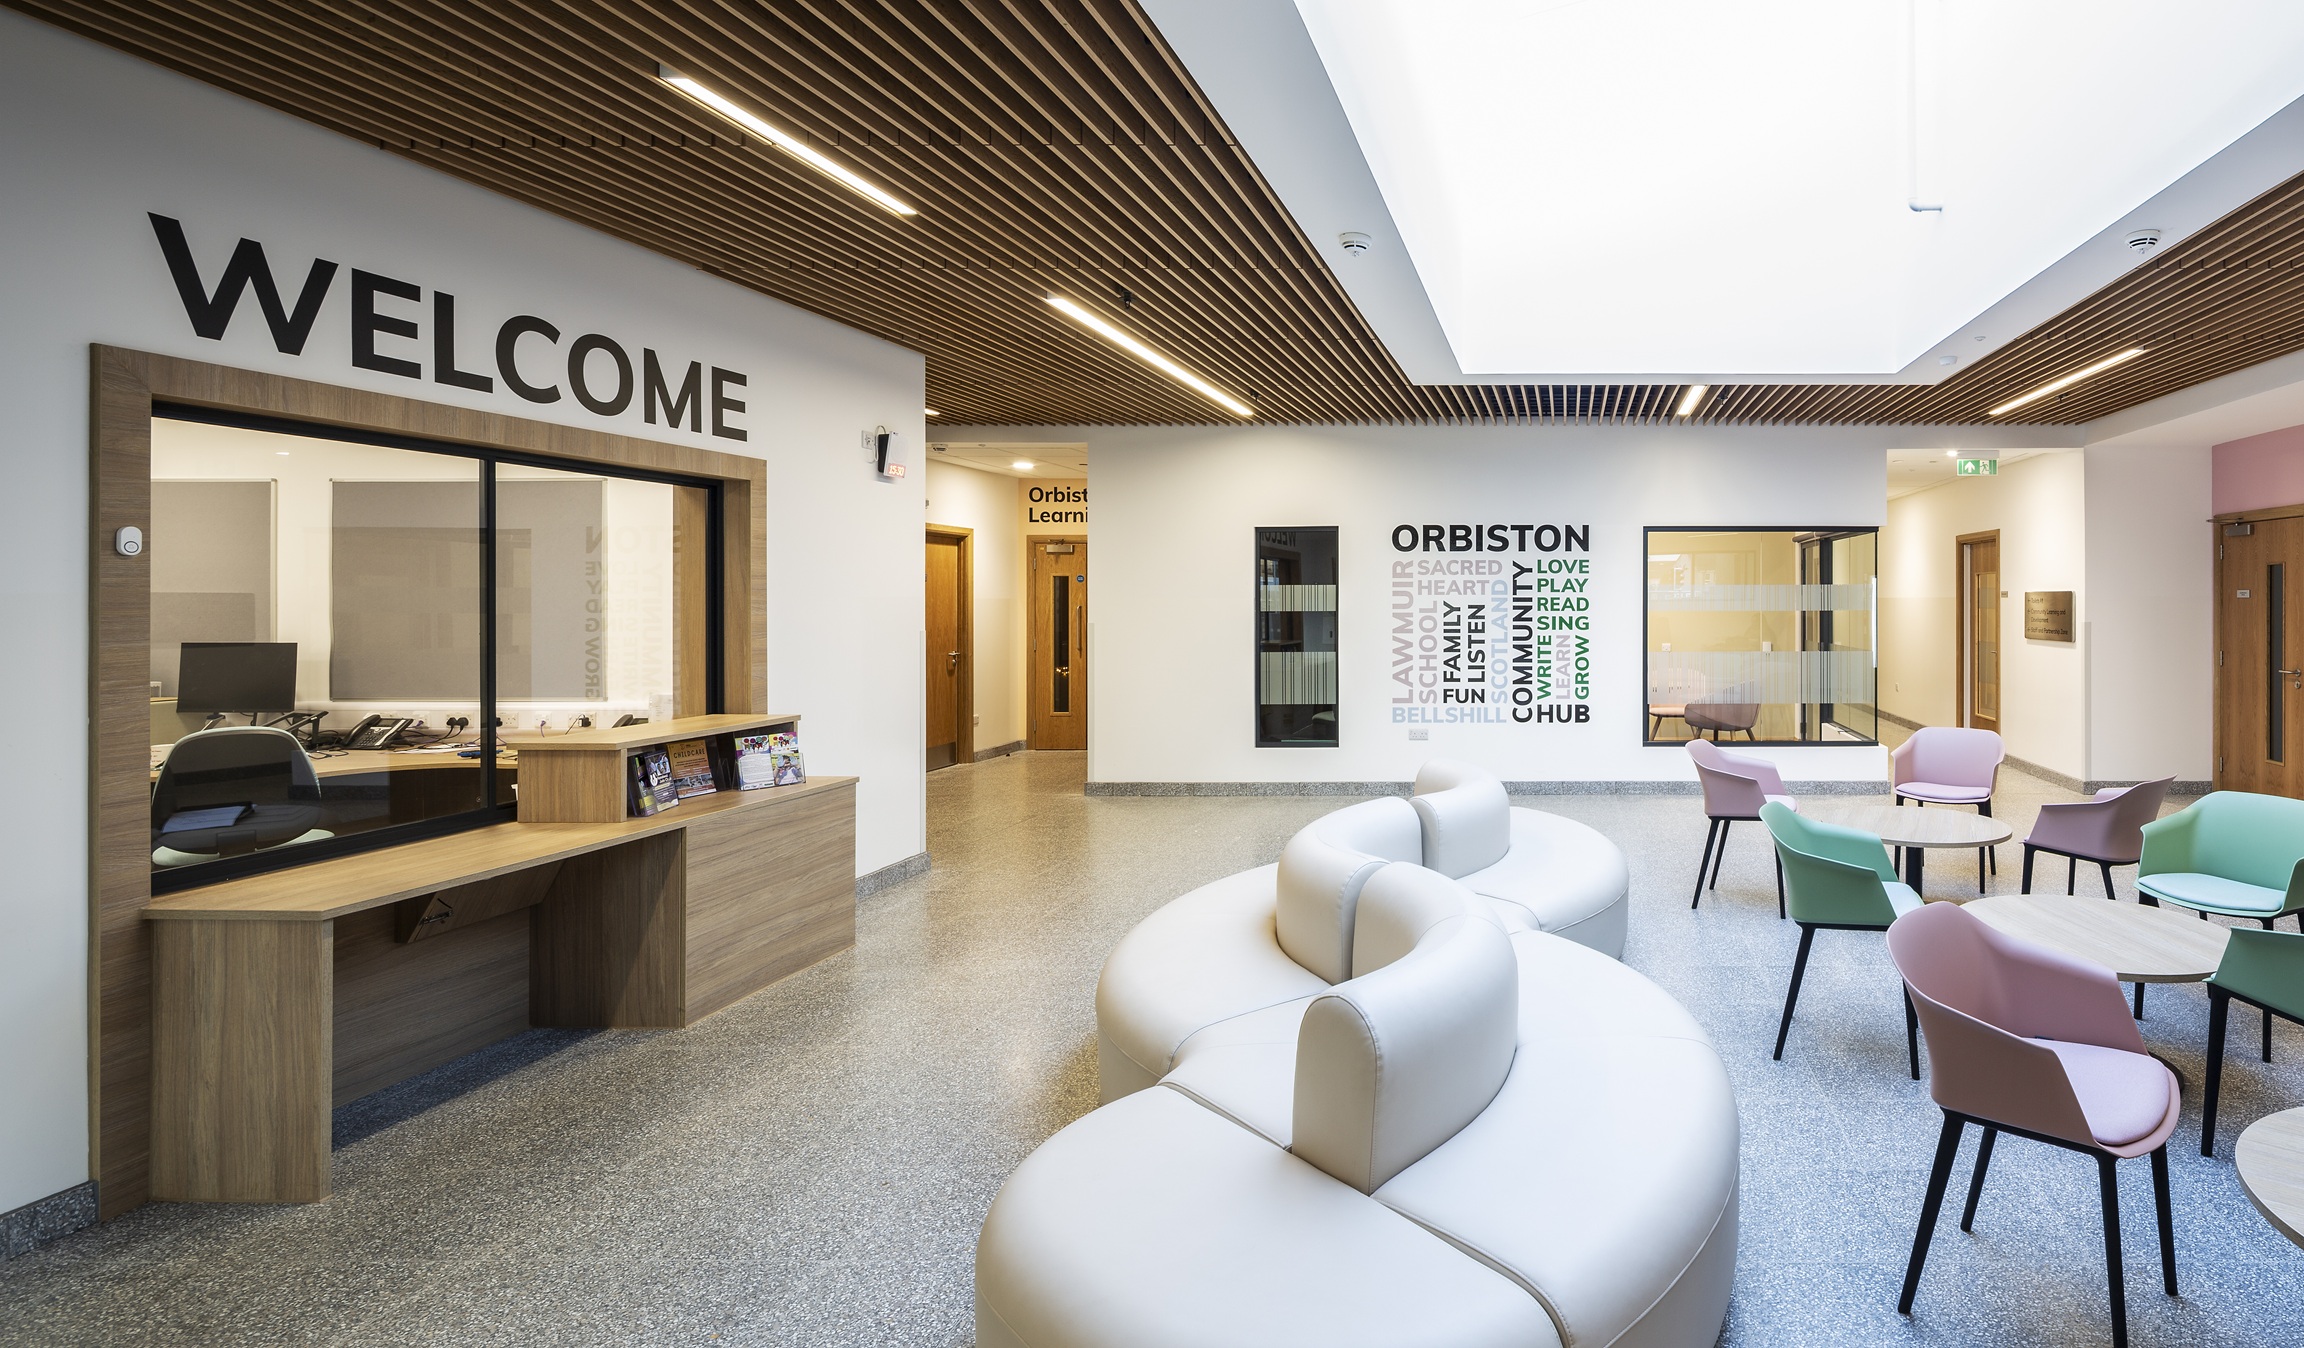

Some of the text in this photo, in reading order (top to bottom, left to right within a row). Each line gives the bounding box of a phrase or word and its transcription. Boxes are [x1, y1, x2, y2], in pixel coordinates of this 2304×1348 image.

[147, 211, 748, 442] WELCOME
[1391, 524, 1590, 552] ORBISTON
[1417, 560, 1503, 575] SACRED
[1537, 559, 1590, 574] LOVE
[1418, 580, 1490, 595] HEART
[1537, 579, 1588, 592] PLAY
[1537, 597, 1589, 611] READ
[1392, 560, 1413, 704] LAWMUIR
[1537, 616, 1589, 630] SING
[1419, 601, 1438, 704] SCHOOL
[1443, 601, 1461, 683] FAMILY
[1468, 604, 1486, 683] LISTEN
[1491, 579, 1508, 704] SCOTLAND
[1512, 560, 1533, 723] COMMUNITY
[1537, 635, 1552, 700] WRITE
[1556, 634, 1570, 700] LEARN
[1575, 635, 1590, 700] GROW
[1443, 688, 1485, 704] FUN
[1392, 707, 1506, 723] BELLSHILL
[1537, 704, 1590, 723] HUB
[673, 748, 705, 759] CHILDCARE
